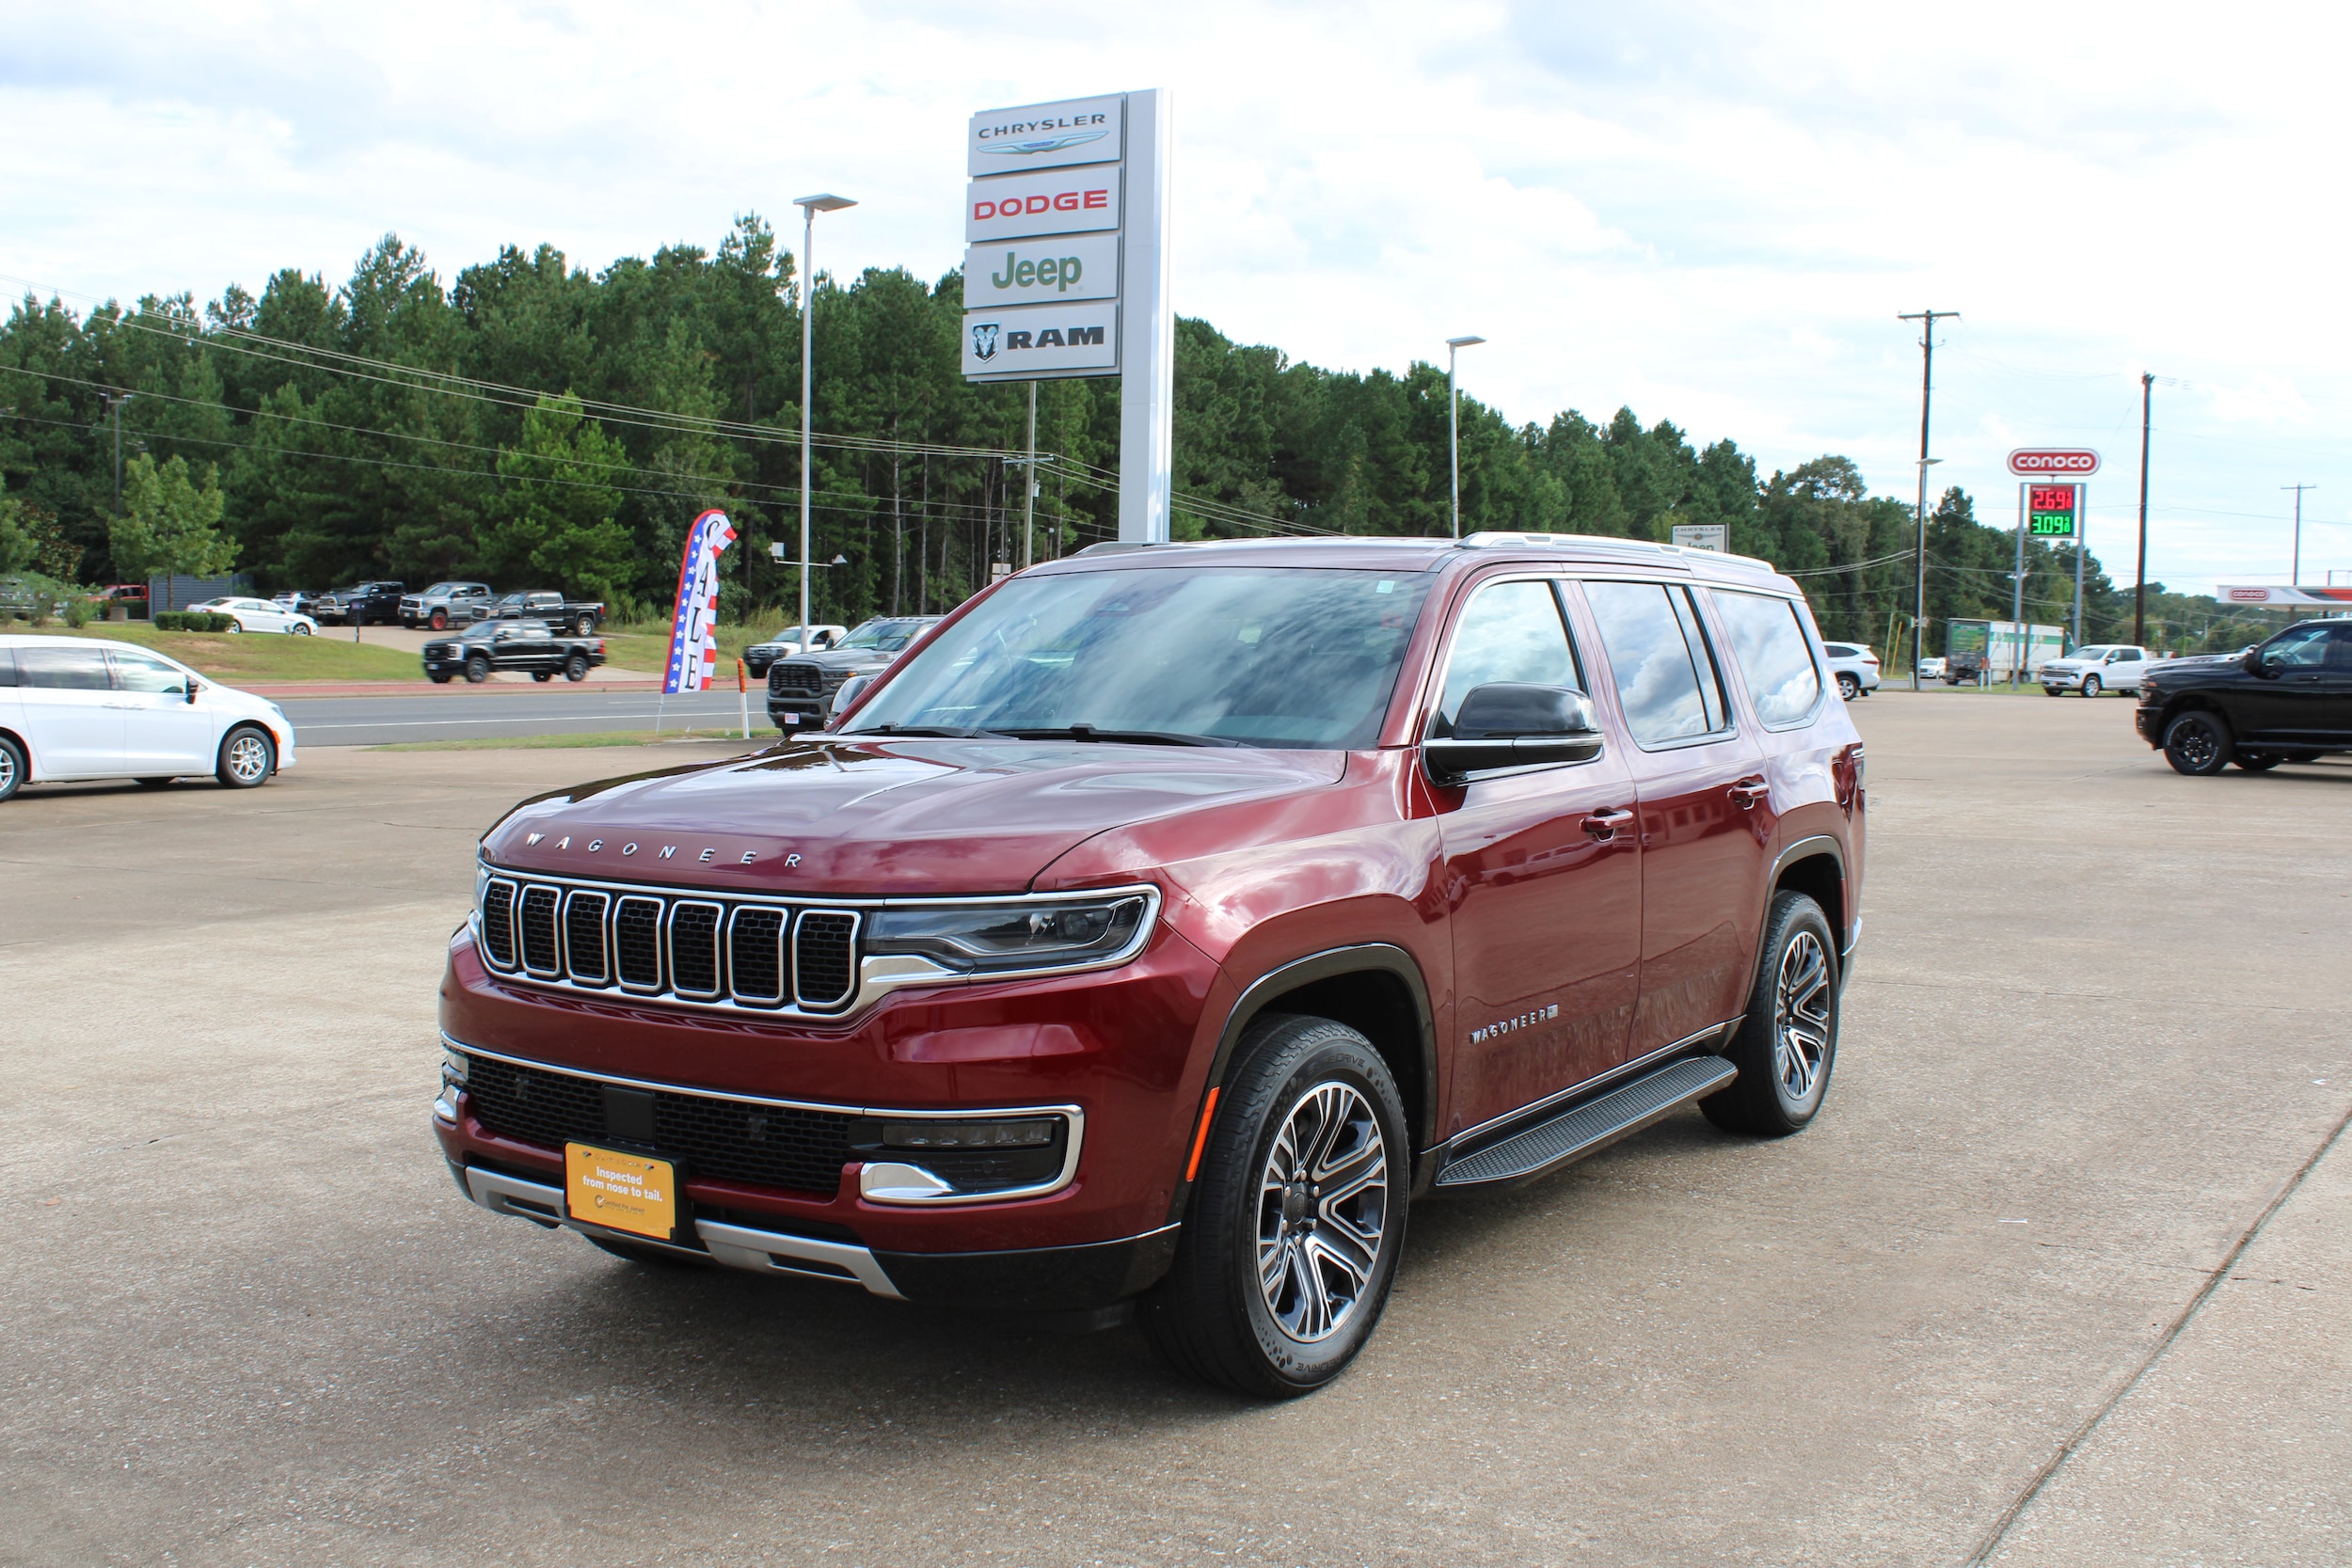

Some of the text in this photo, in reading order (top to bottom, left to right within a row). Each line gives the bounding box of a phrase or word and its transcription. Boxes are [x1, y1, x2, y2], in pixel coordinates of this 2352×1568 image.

[977, 113, 1107, 139] CHRYSLER
[974, 189, 1108, 221] DODGE
[992, 251, 1082, 293] Jeep
[1007, 325, 1104, 351] RAM
[526, 832, 803, 869] WAGONEER
[1470, 1008, 1546, 1045] WAGONEER
[582, 1175, 663, 1202] from nose to tail.
[596, 1166, 643, 1186] Inspected
